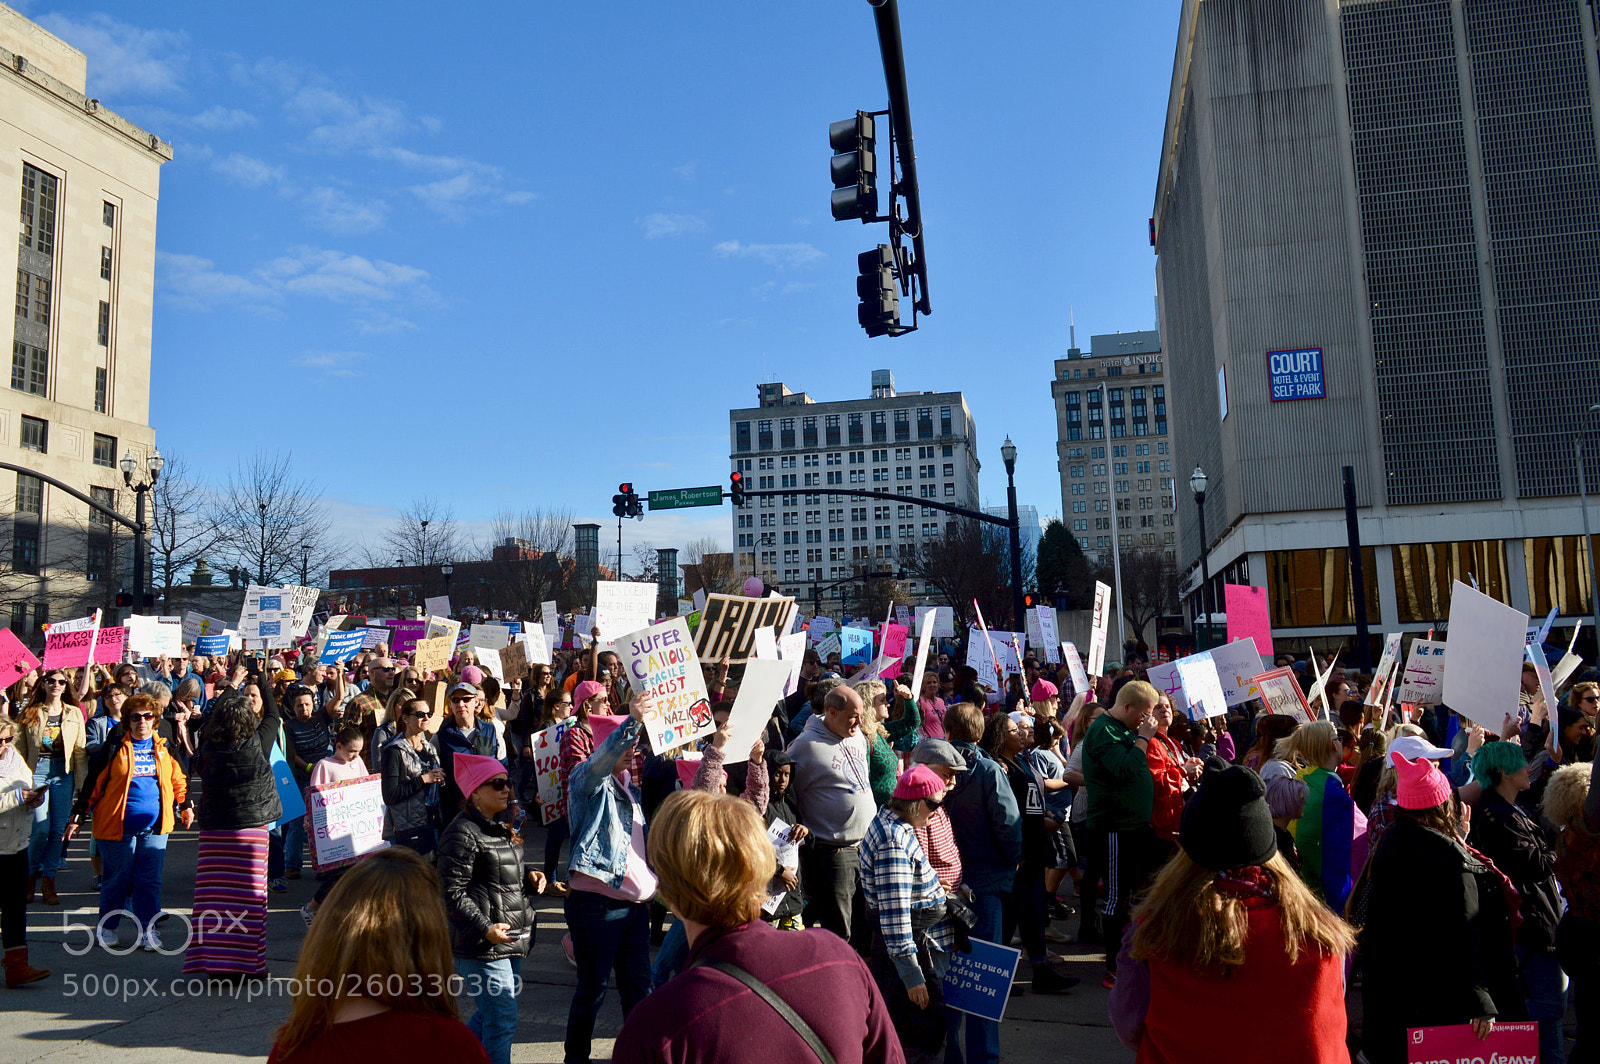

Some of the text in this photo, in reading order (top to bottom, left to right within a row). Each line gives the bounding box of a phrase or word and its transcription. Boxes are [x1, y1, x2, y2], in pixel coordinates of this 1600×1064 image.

[1100, 354, 1164, 368] hotel INDIG
[1271, 352, 1320, 375] COURT
[1273, 373, 1320, 385] HOTEL & EVENT
[1274, 383, 1322, 398] SELF PARK
[653, 490, 718, 502] James Robertson
[50, 627, 123, 644] MY COUAGE
[632, 629, 682, 656] SUPER
[848, 634, 861, 644] HEAR
[50, 639, 89, 650] ALWAYS
[418, 642, 429, 650] WE
[1416, 644, 1430, 656] WE
[426, 650, 440, 659] NOT
[431, 658, 448, 668] SILENT
[641, 665, 686, 692] FRAGILE
[1236, 676, 1255, 688] Pizz
[648, 691, 700, 722] SEXIST
[664, 709, 690, 726] NAZI
[540, 731, 548, 748] I
[658, 722, 699, 747] POTUS
[313, 790, 345, 808] WOMEN
[316, 820, 348, 840] STOPS
[966, 959, 1010, 980] Women's
[960, 980, 972, 989] of
[975, 984, 997, 998] Men
